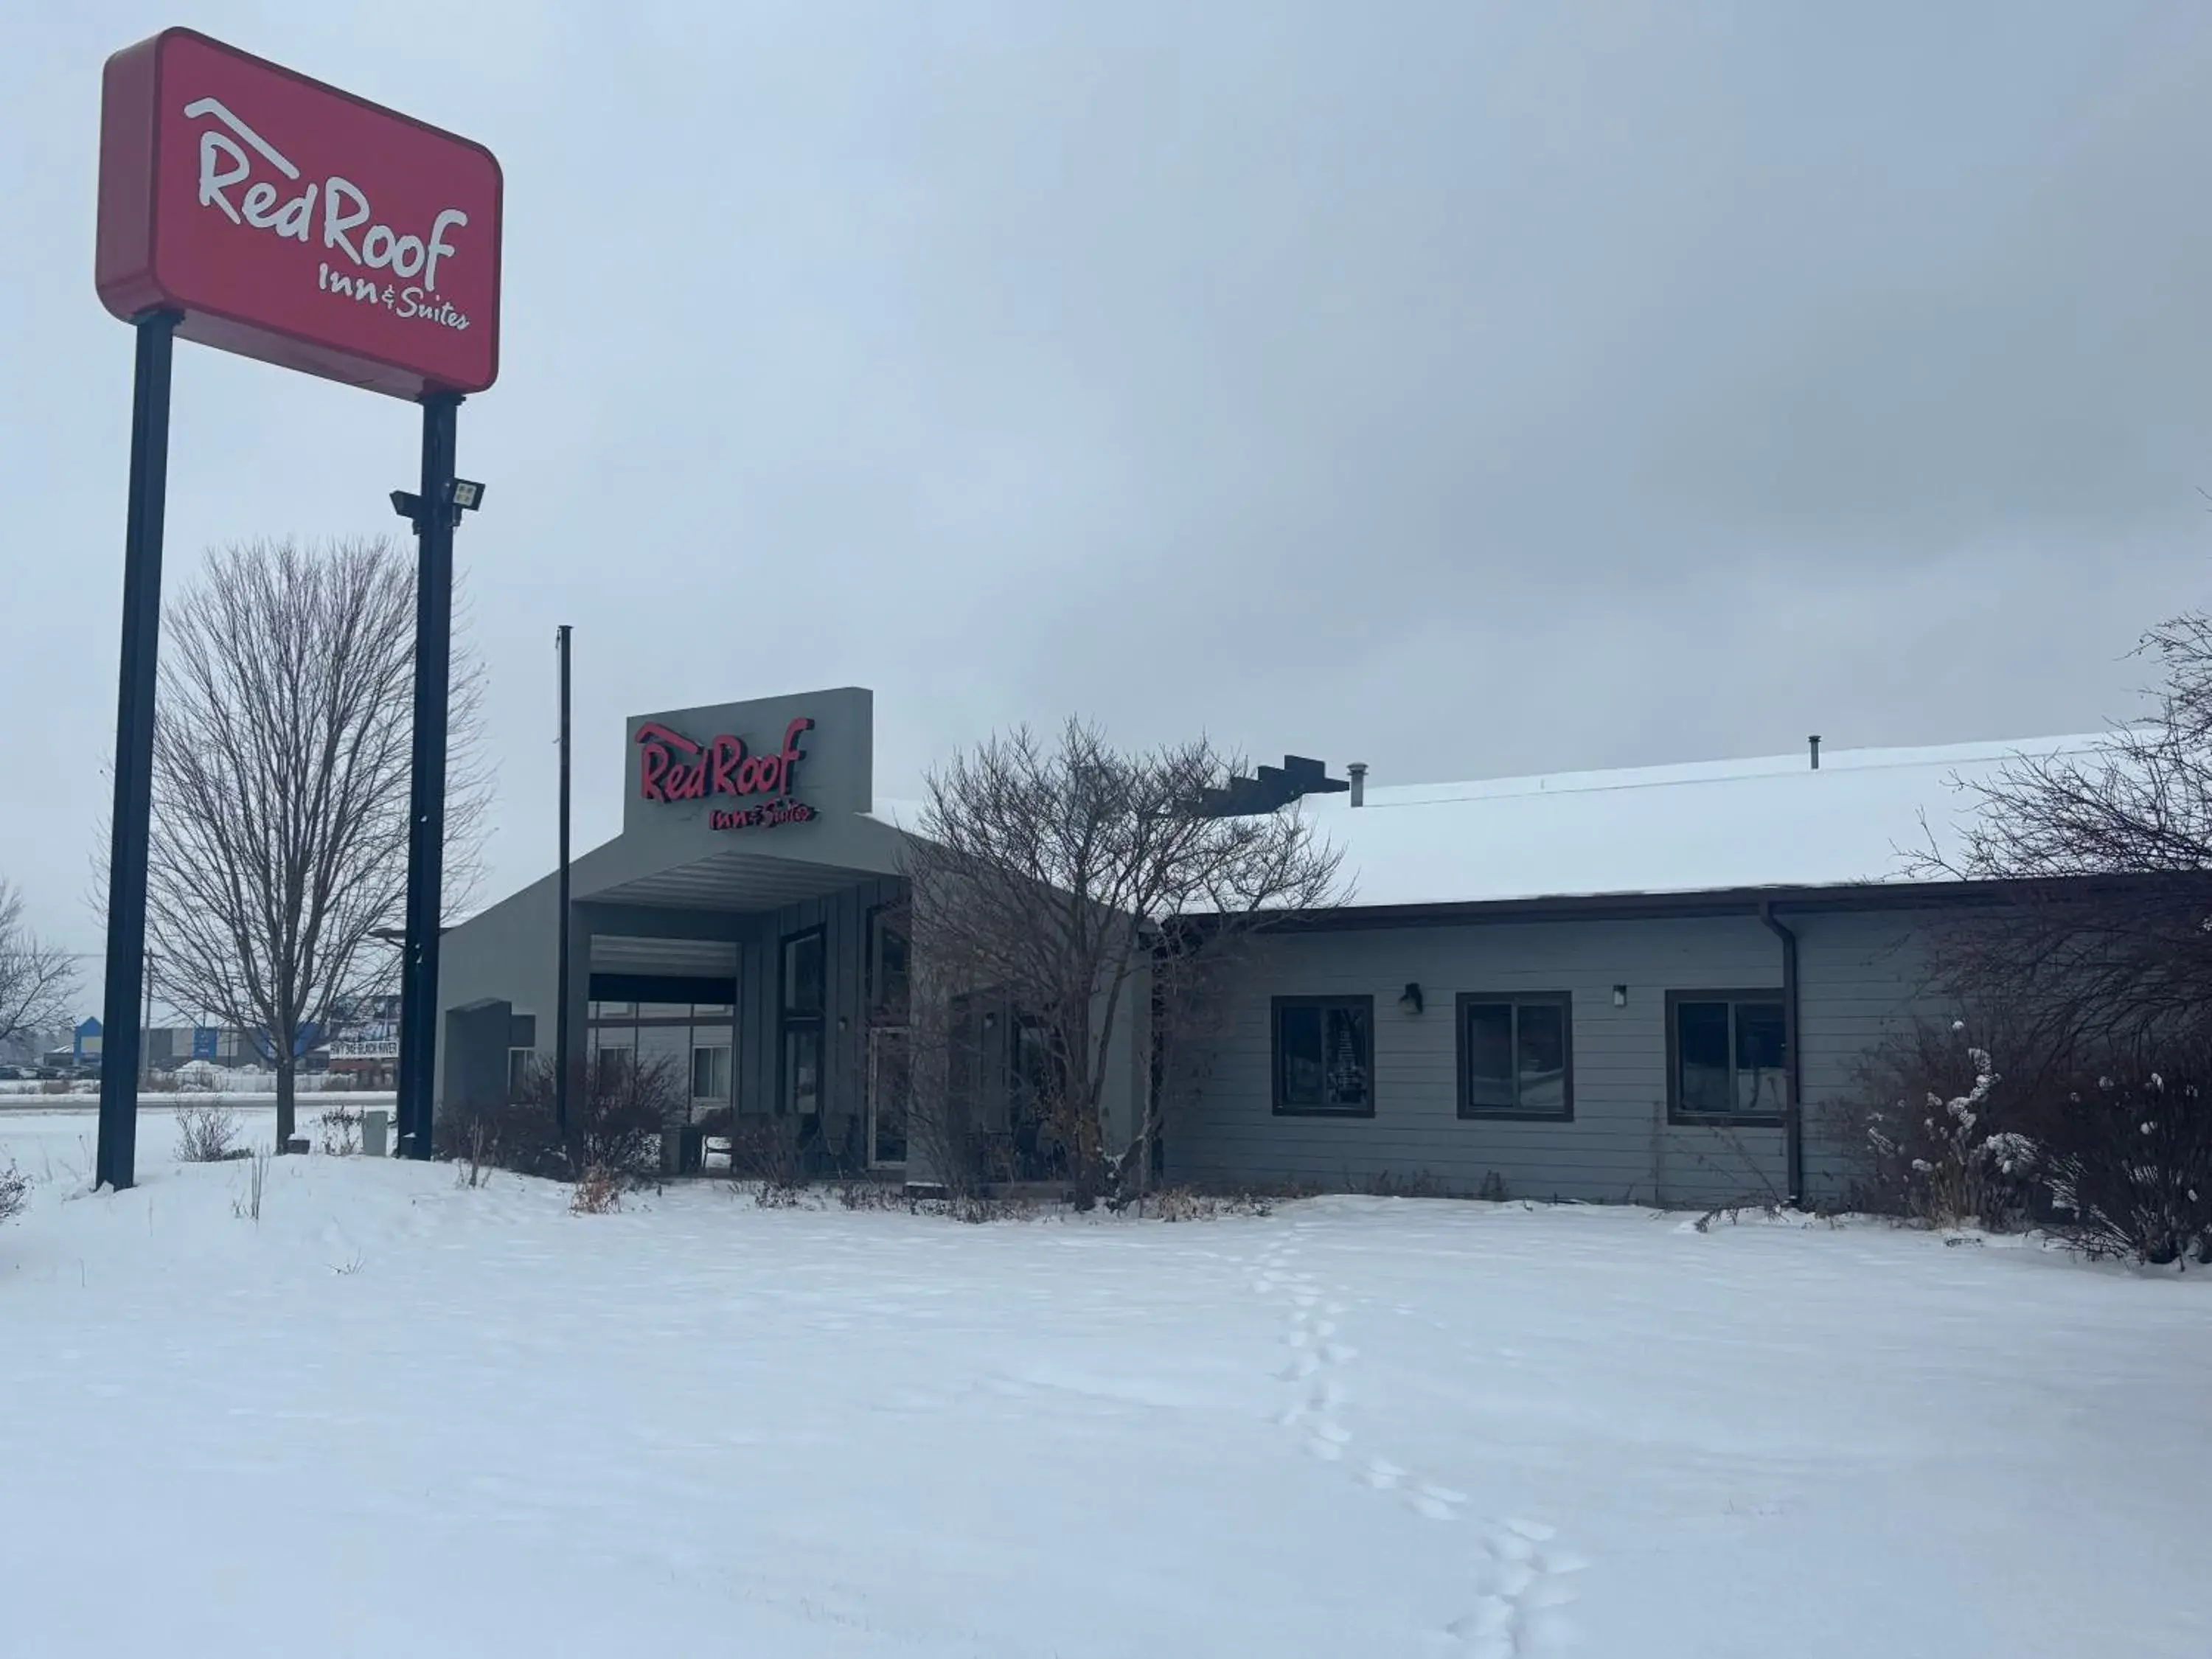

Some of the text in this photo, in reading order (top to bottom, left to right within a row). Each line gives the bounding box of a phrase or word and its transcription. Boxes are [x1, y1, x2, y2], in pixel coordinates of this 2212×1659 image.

[199, 131, 467, 291] Red Roof
[319, 262, 470, 330] Inn & Suites
